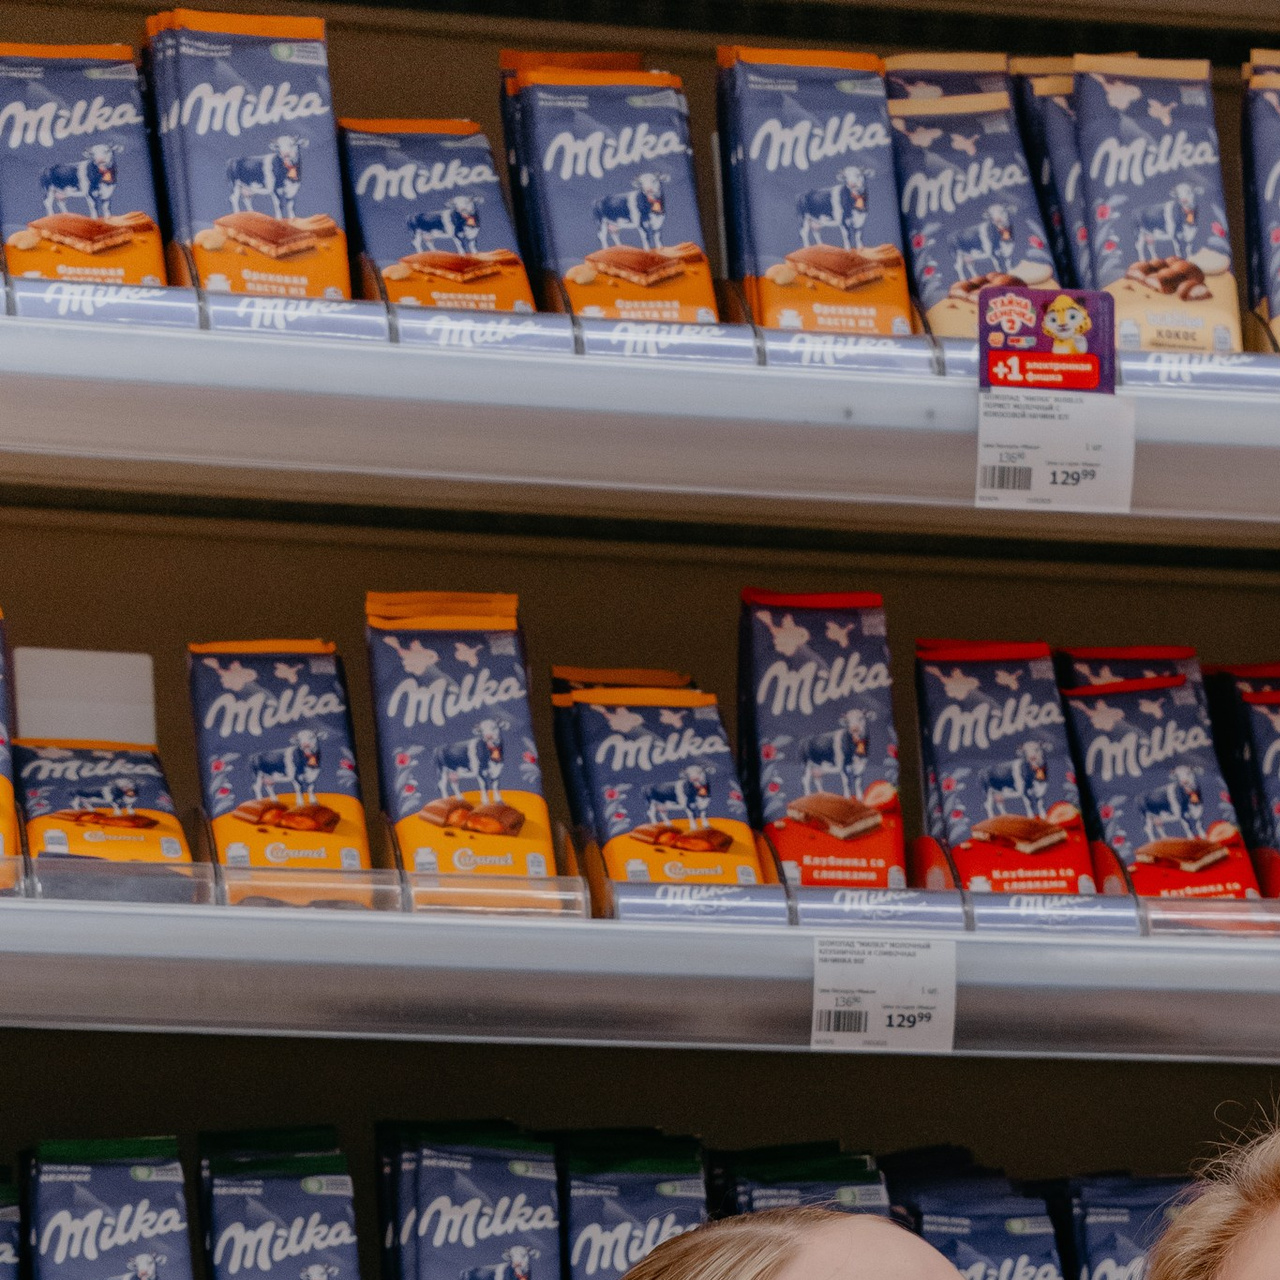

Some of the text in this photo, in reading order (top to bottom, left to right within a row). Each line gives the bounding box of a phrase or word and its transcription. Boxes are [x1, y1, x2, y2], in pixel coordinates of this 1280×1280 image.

[0, 95, 146, 149] Milka
[180, 81, 331, 136] Milka
[543, 121, 688, 181] Milka
[750, 112, 892, 171] Milka
[1091, 131, 1220, 188] Milka
[356, 160, 500, 201] Milka
[902, 158, 1030, 217] Milka
[993, 356, 1024, 381] +1
[204, 684, 346, 738] Milka
[386, 669, 527, 727] Milka
[756, 652, 893, 716] Milka
[595, 727, 730, 773] Milka
[932, 692, 1066, 753] Milka
[1085, 721, 1212, 781] Milka
[20, 752, 165, 780] Milka
[39, 1198, 188, 1265] Milka
[214, 1212, 358, 1275] Milka
[419, 1194, 559, 1248] Milka
[570, 1212, 700, 1276] Milk
